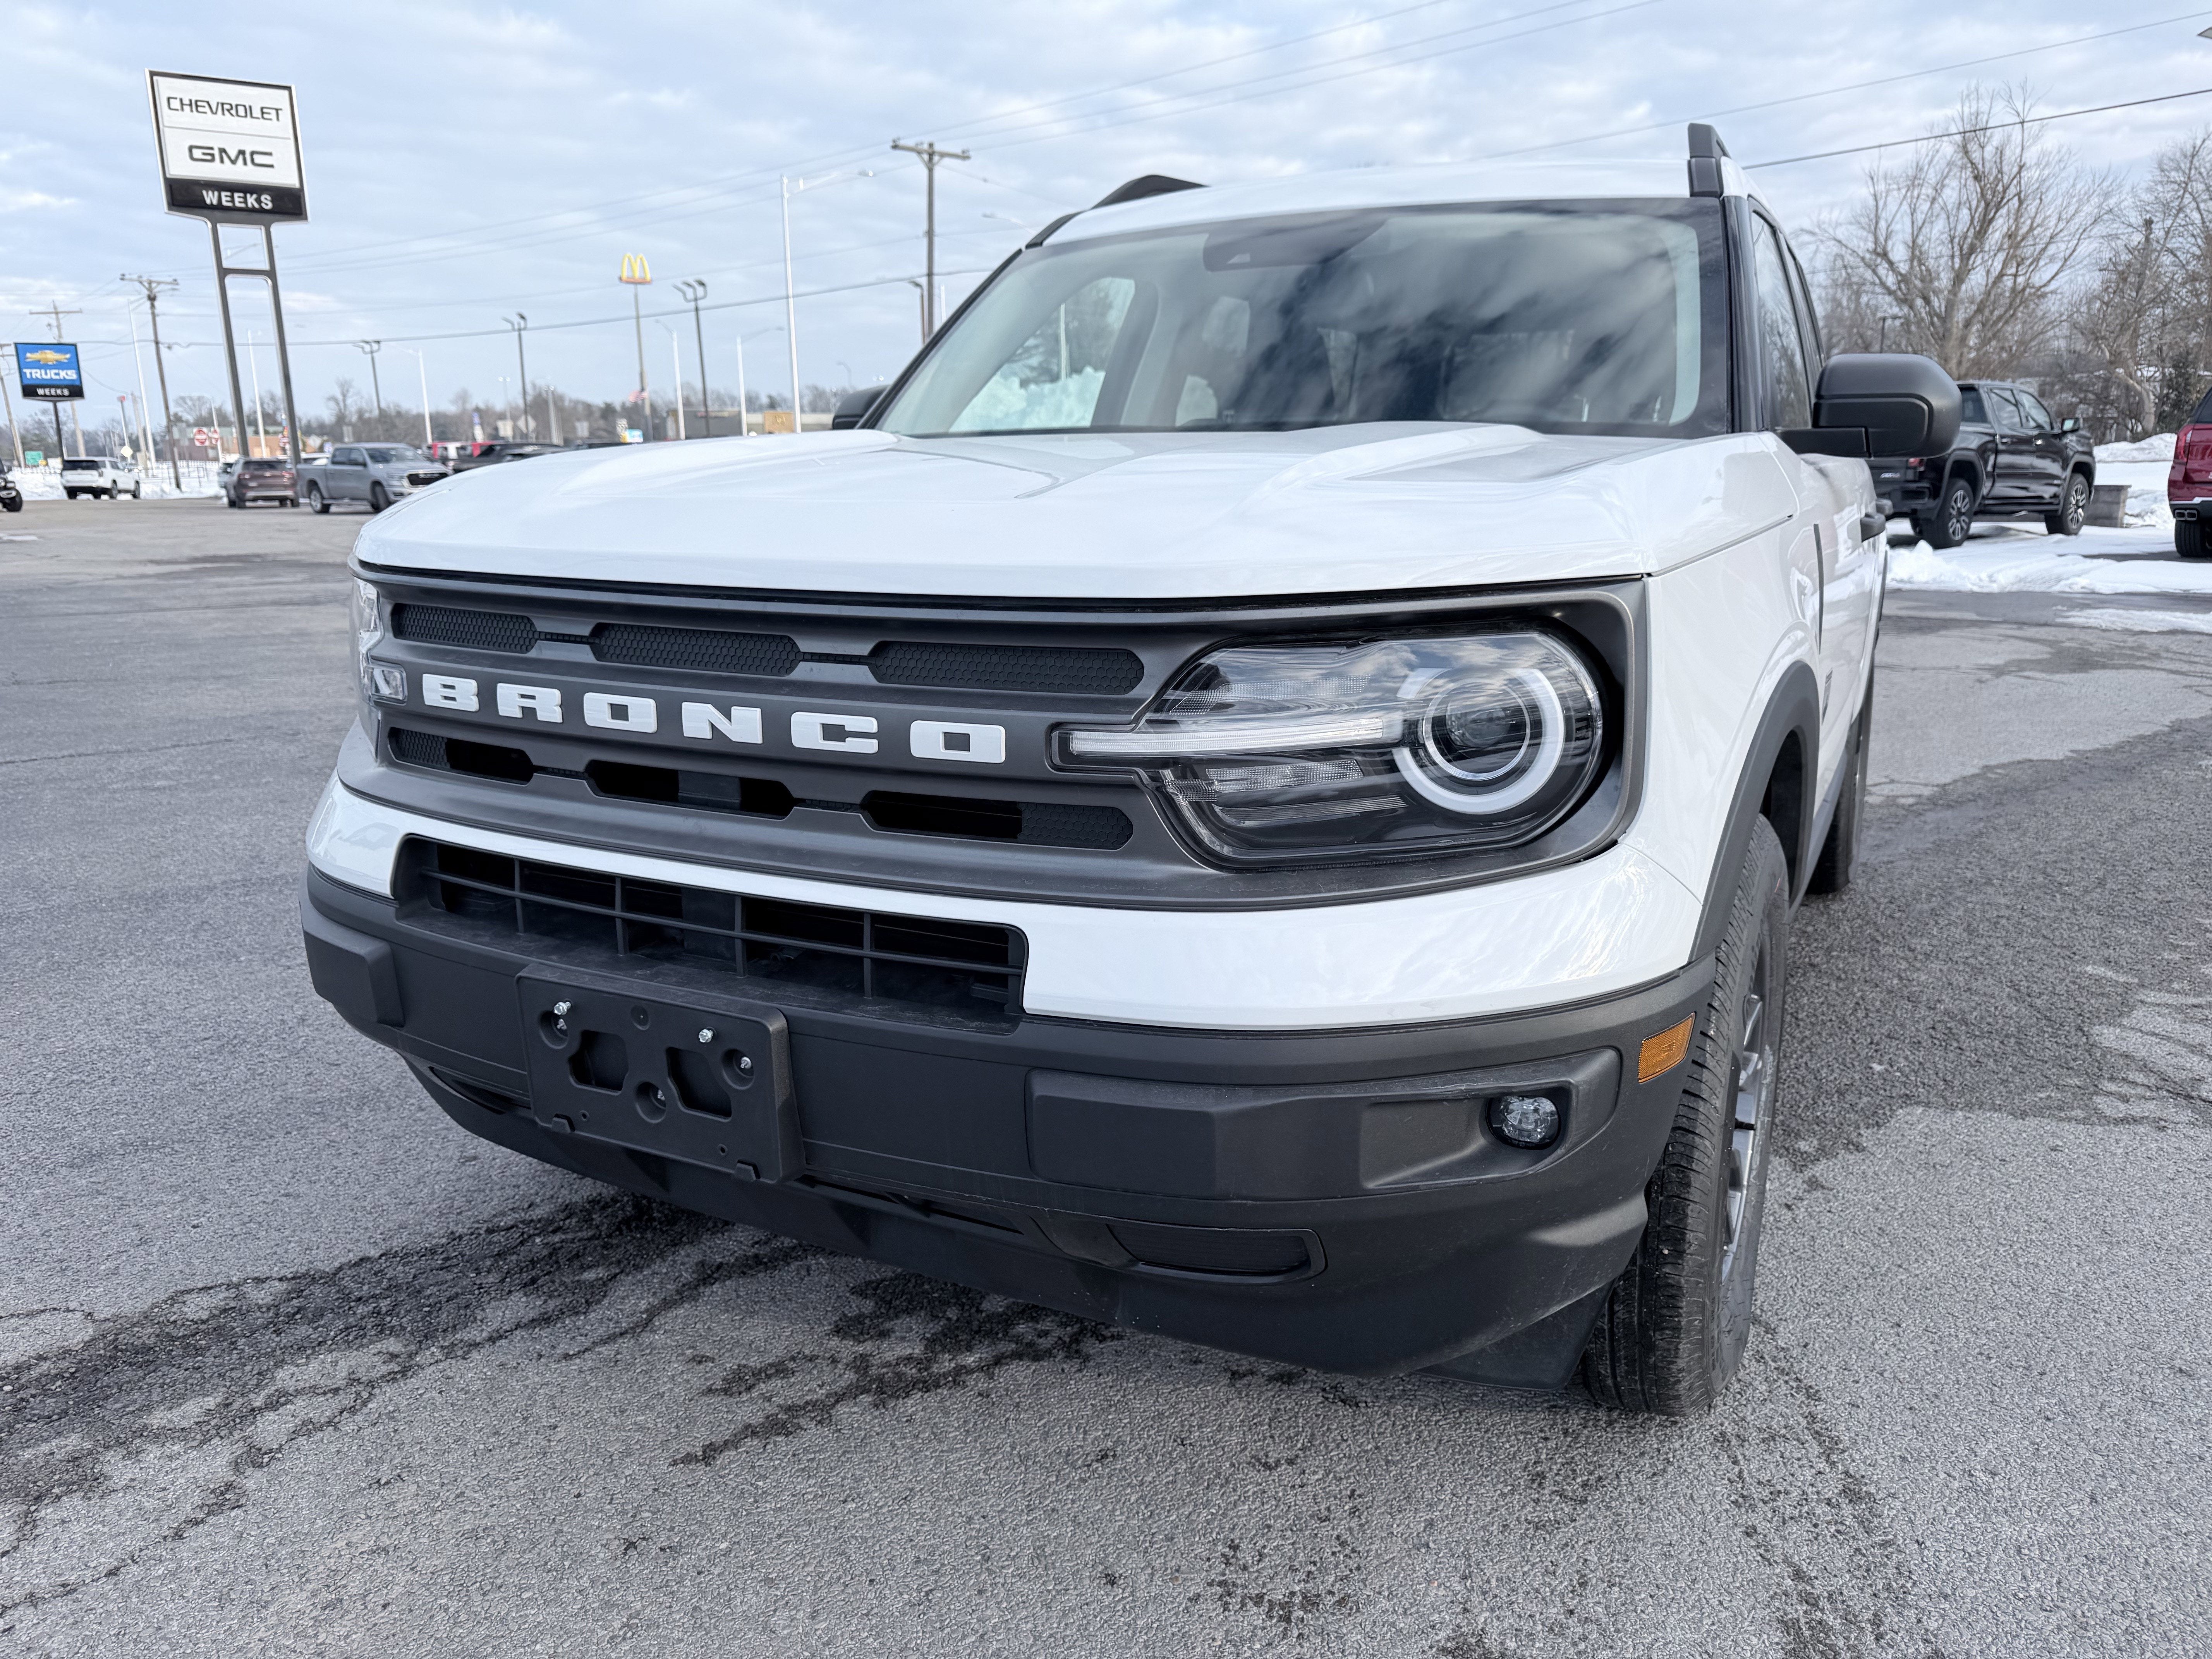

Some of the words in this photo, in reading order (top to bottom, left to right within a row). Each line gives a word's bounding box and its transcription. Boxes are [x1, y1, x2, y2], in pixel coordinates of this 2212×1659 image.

[167, 96, 283, 122] CHEVROLET
[188, 144, 275, 168] GMC
[202, 190, 273, 210] WEEKS
[23, 369, 77, 380] TRUCKS
[37, 388, 70, 396] WEEKS
[422, 673, 1006, 764] BRONCO
